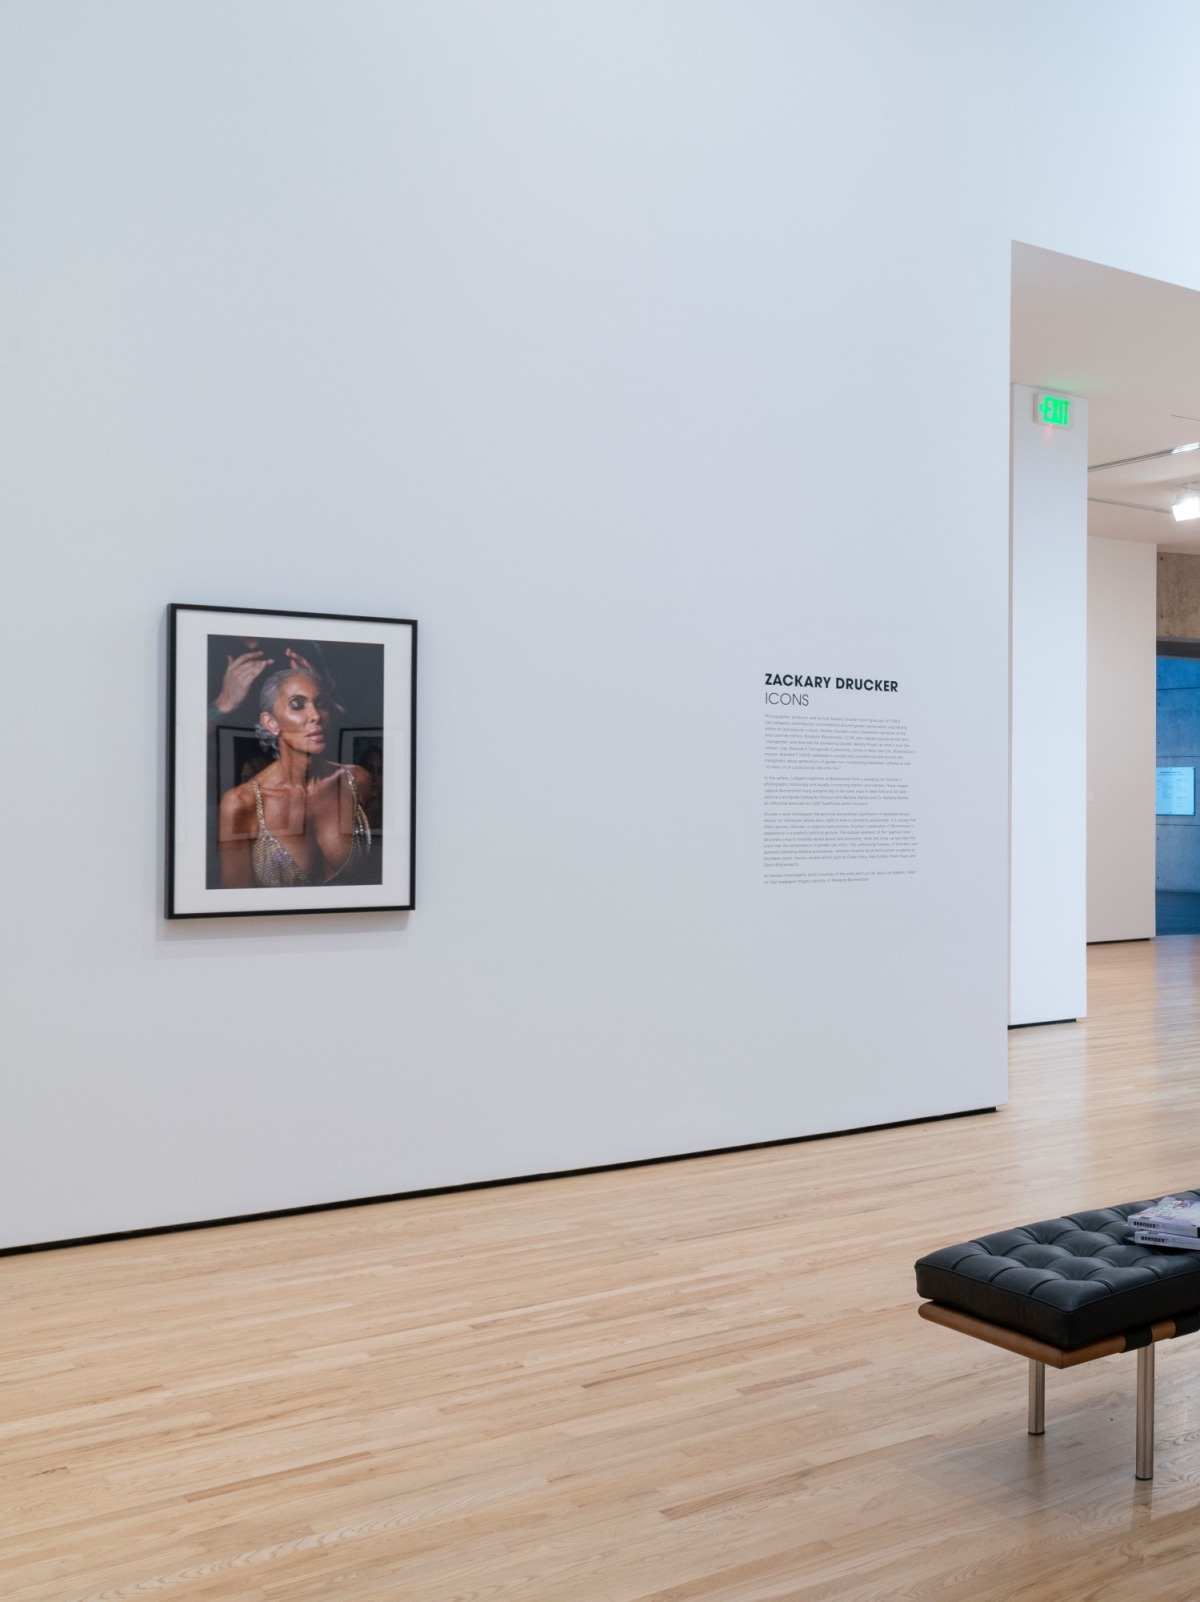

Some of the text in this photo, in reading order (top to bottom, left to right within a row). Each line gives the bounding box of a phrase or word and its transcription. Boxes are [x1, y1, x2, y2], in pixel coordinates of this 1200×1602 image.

[1043, 395, 1070, 427] EXIT
[765, 673, 898, 692] ZACKARY DRUCKER
[765, 691, 809, 707] ICONS
